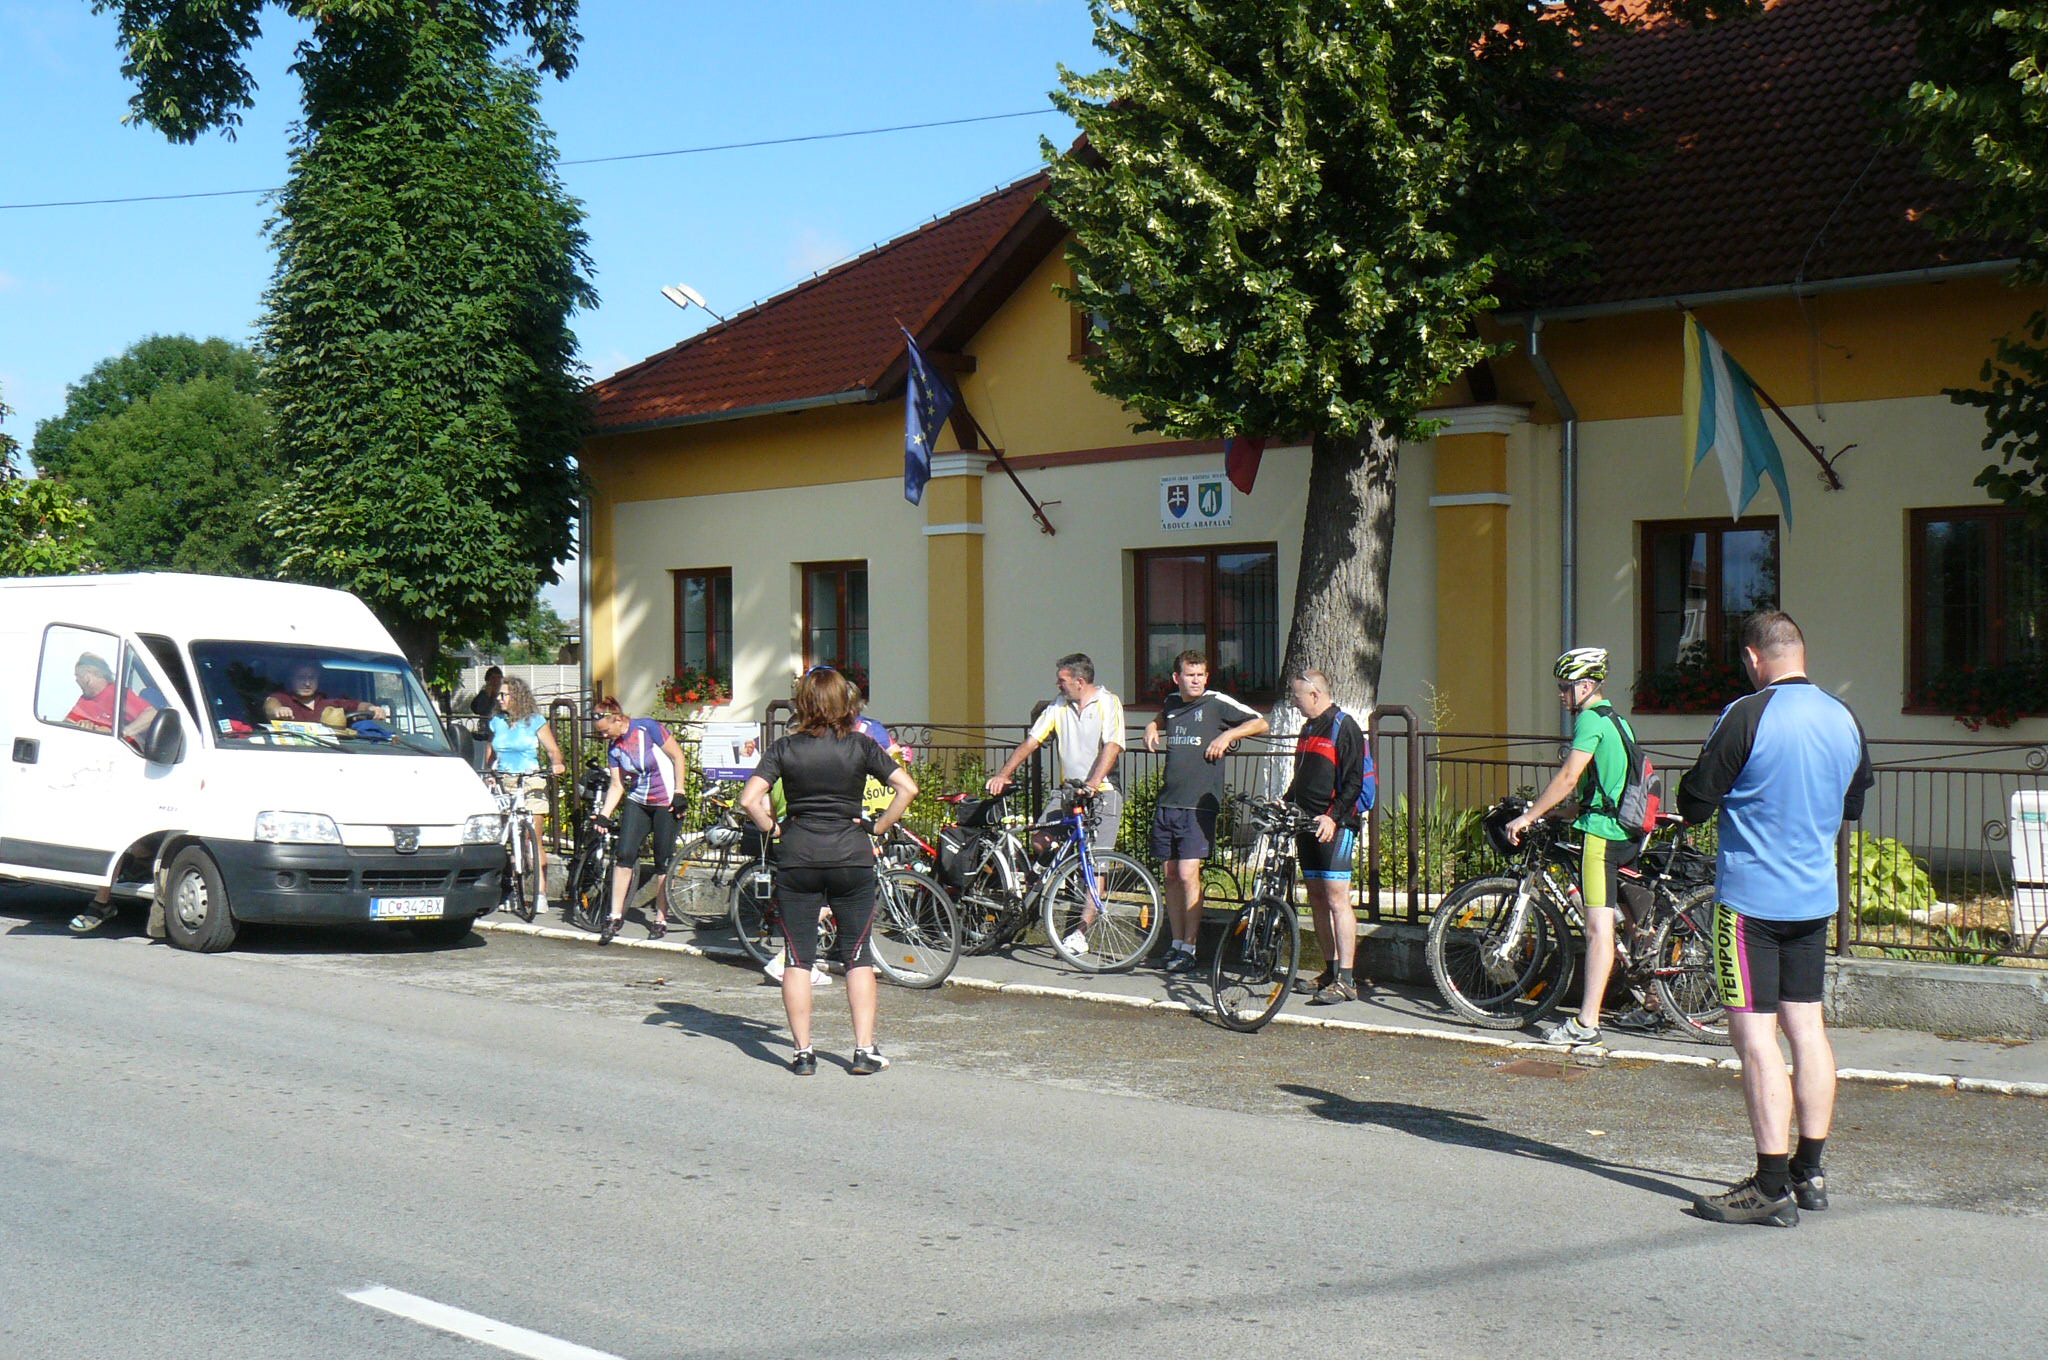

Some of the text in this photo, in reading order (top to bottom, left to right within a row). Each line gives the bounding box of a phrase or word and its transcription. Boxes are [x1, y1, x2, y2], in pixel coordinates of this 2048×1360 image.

[1167, 735, 1202, 746] mirates
[379, 899, 442, 914] LC 342BX
